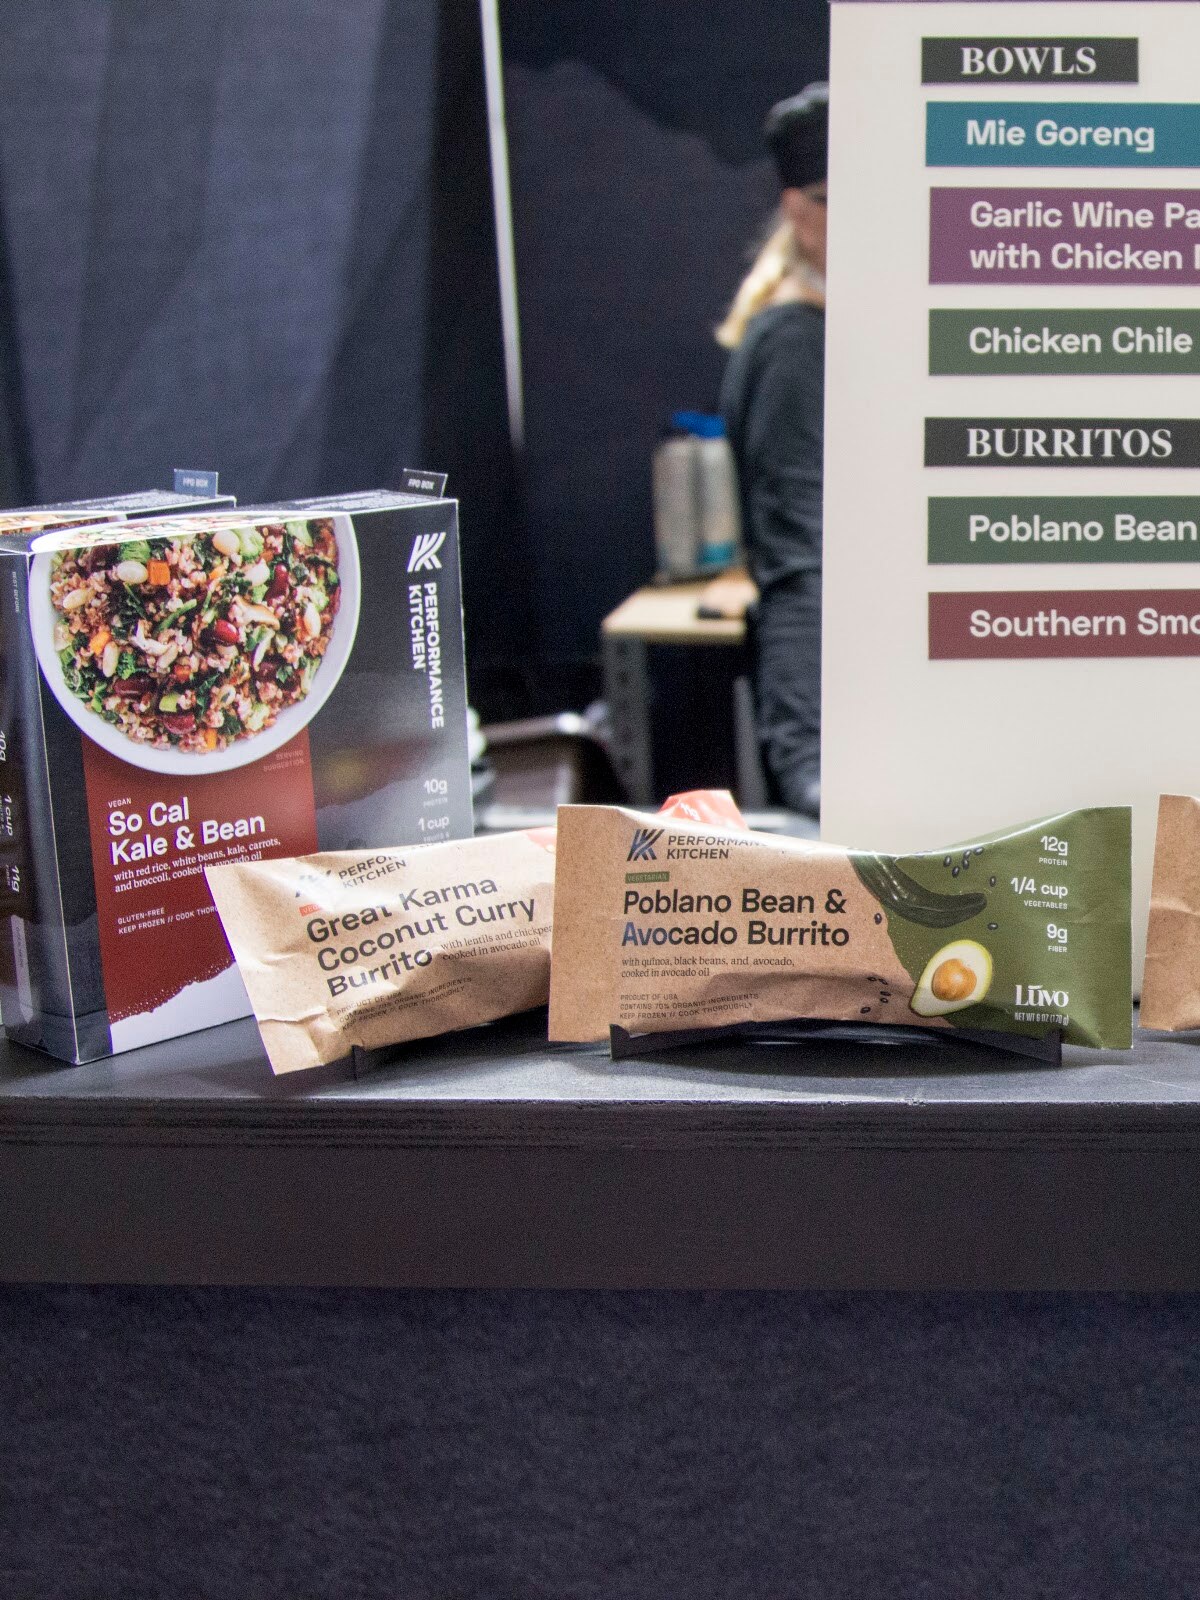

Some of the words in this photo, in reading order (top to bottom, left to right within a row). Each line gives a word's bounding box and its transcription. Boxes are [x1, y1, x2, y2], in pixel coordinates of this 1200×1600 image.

[960, 46, 1097, 77] BOWLS
[966, 119, 1026, 147] Mie
[1035, 119, 1155, 153] Goreng
[969, 201, 1063, 230] Garlic
[1071, 201, 1155, 230] Wine
[969, 243, 1042, 271] with
[1050, 242, 1184, 272] Chicken
[968, 326, 1102, 355] Chicken
[1110, 327, 1193, 355] Chile
[966, 428, 1173, 459] BURRITOS
[968, 514, 1104, 543] Poblano
[1113, 514, 1198, 543] Bean
[408, 584, 426, 671] KITCHEN
[969, 609, 1126, 638] Southern
[423, 582, 446, 729] PERFORMANCE
[424, 779, 448, 795] 10g
[108, 798, 131, 808] VEGAN
[109, 811, 143, 836] So
[149, 797, 190, 827] Cal
[418, 817, 425, 831] 1
[427, 816, 449, 830] cup
[111, 834, 168, 865] Kale
[175, 826, 195, 850] &
[202, 815, 266, 845] Bean
[1040, 835, 1068, 856] 12g
[113, 870, 134, 881] with
[136, 866, 151, 877] red
[152, 862, 171, 873] rice,
[172, 855, 197, 868] white
[198, 850, 226, 863] beans,
[227, 844, 248, 857] kale,
[249, 838, 281, 850] carrots,
[666, 849, 729, 859] KITCHEN
[1038, 858, 1068, 866] PROTEIN
[115, 882, 133, 892] and
[133, 873, 171, 889] broccoli,
[172, 866, 203, 879] cooked
[250, 852, 262, 863] oil
[342, 860, 406, 888] KITCHEN
[1010, 876, 1037, 895] 1/4
[1041, 883, 1068, 898] cup
[307, 904, 392, 943] Great
[399, 879, 498, 913] Karma
[623, 889, 732, 914] Poblano
[741, 888, 814, 914] Bean
[824, 888, 847, 914] &
[1023, 900, 1068, 910] VEGETABLES
[117, 907, 165, 924] GLUTEN-FREE
[118, 924, 137, 935] KEEP
[138, 918, 166, 930] FROZEN
[175, 912, 195, 921] COOK
[317, 913, 448, 971] Coconut
[455, 898, 536, 927] Curry
[441, 939, 463, 950] with
[464, 934, 493, 946] lentils
[495, 931, 513, 941] and
[622, 921, 738, 946] Avocado
[748, 920, 850, 946] Burrito
[1046, 923, 1068, 943] 9g
[442, 948, 477, 960] cooked
[479, 947, 489, 955] in
[490, 940, 528, 953] avocado
[530, 938, 541, 946] oil
[621, 958, 640, 966] with
[641, 957, 672, 967] quinoa,
[674, 956, 698, 965] black
[699, 956, 728, 966] beans,
[731, 956, 749, 965] and
[753, 956, 795, 967] avocado,
[1047, 945, 1068, 953] FIBER
[326, 949, 433, 997] Burrito
[621, 968, 649, 977] cooked
[651, 968, 659, 977] in
[661, 968, 696, 977] avocado
[698, 967, 710, 977] oil
[672, 1000, 706, 1009] ORGANIC
[678, 1009, 700, 1017] COOK
